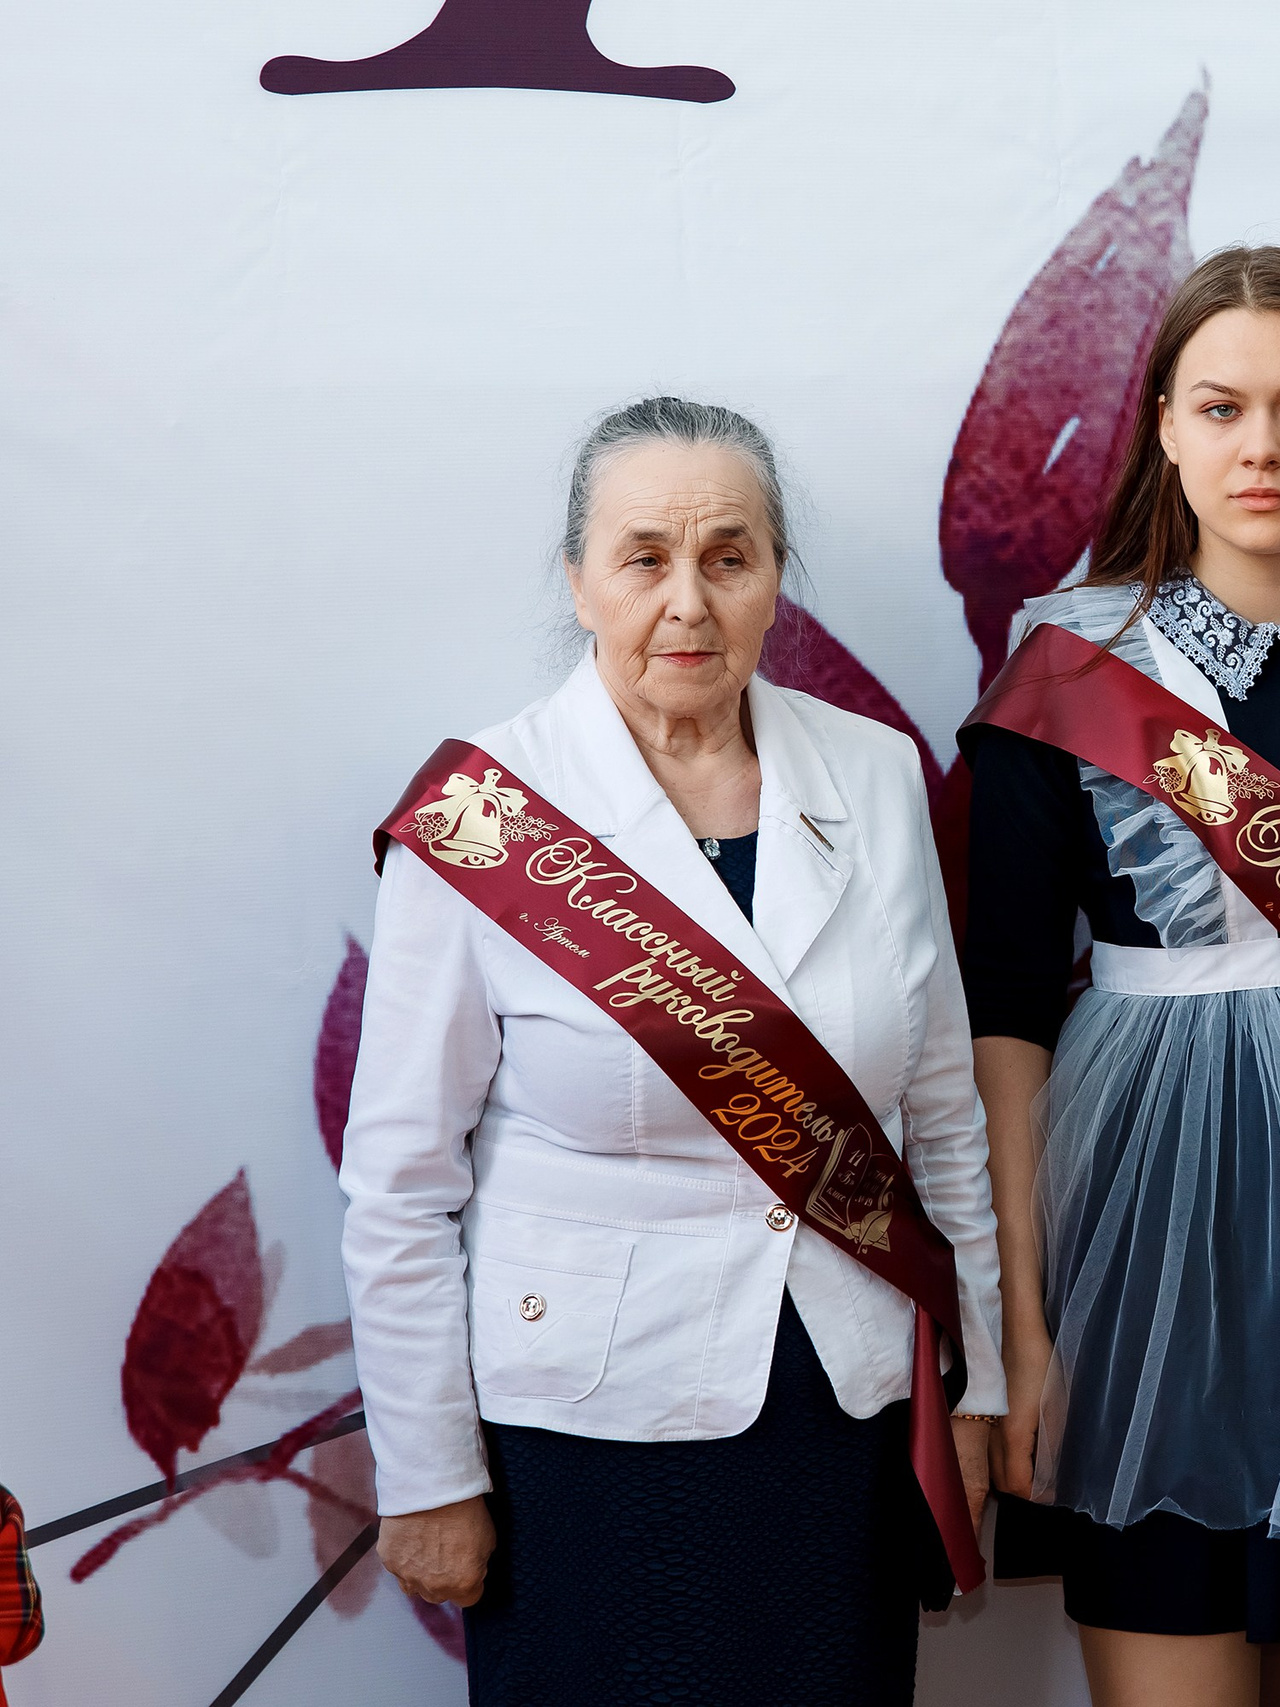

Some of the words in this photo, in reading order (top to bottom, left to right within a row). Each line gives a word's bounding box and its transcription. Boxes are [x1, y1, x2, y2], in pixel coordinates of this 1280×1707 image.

[525, 836, 744, 1003] Классный
[533, 916, 591, 959] Артем
[593, 956, 836, 1142] руководитель
[710, 1092, 818, 1179] 2024
